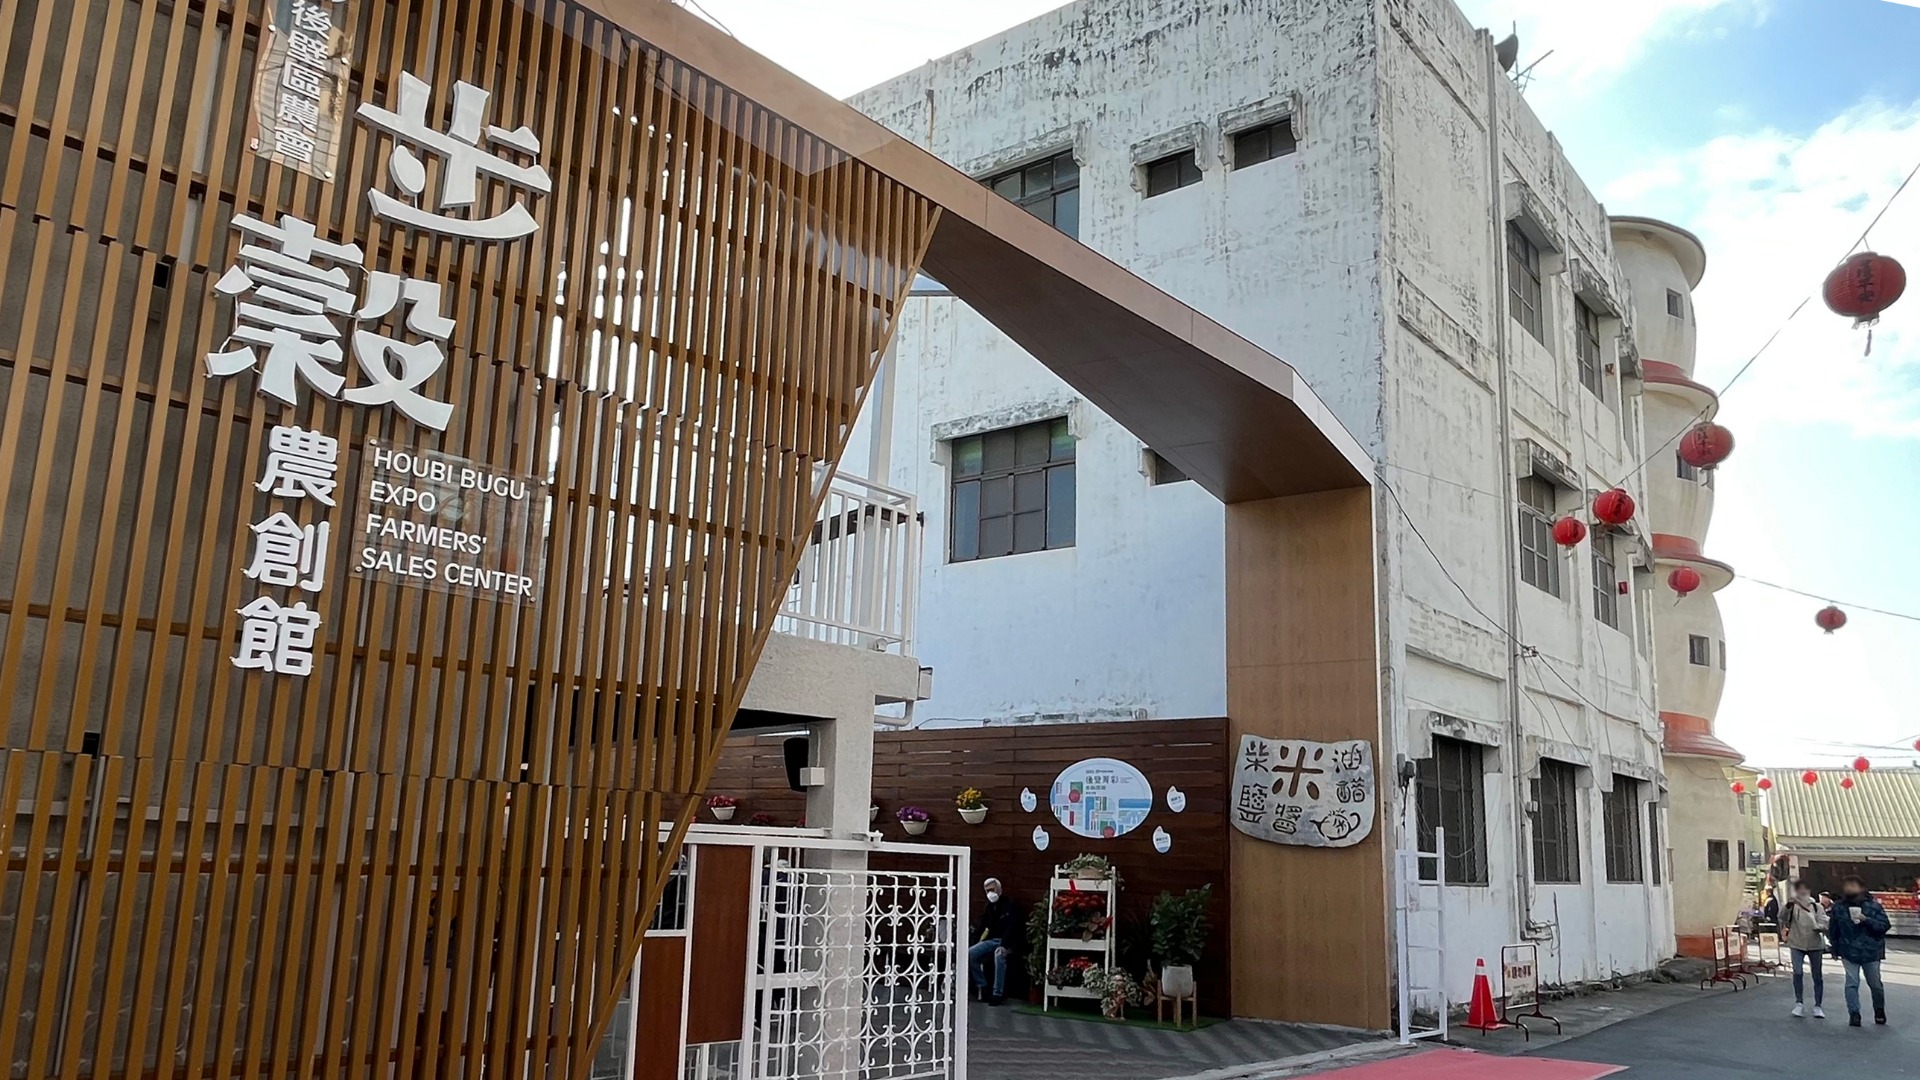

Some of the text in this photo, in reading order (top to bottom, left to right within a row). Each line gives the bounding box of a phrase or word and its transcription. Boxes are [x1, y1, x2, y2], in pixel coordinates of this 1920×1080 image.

[275, 0, 333, 164] 後壁區農會
[369, 480, 436, 512] EXPO
[374, 447, 525, 500] HOUBI BUGU
[230, 425, 341, 677] 農創館
[366, 513, 487, 555] FARMERS'
[361, 547, 533, 597] SALES CENTER
